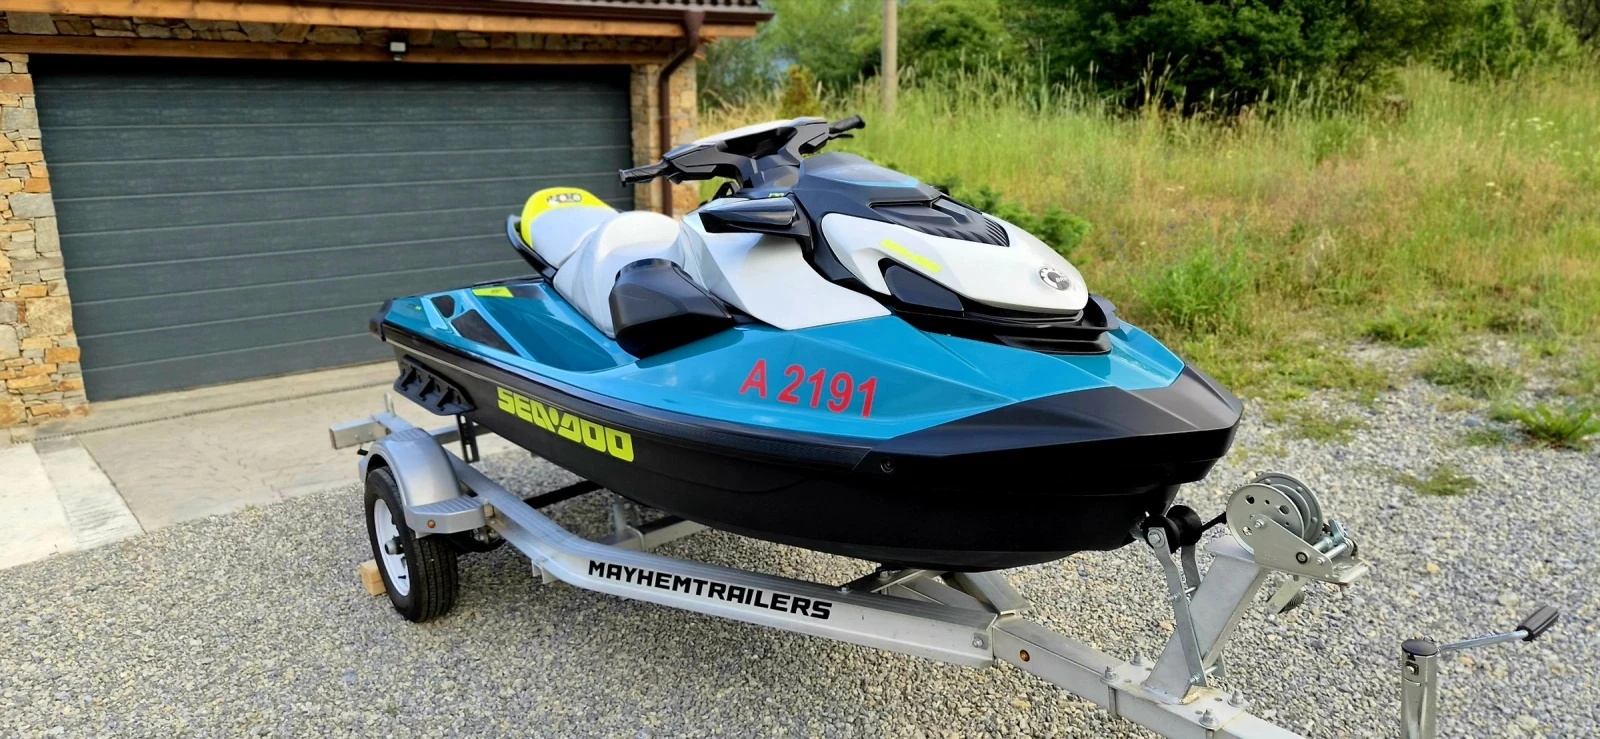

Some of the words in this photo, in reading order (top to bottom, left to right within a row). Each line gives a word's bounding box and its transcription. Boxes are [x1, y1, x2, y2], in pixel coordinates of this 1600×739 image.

[738, 358, 767, 398] A
[777, 364, 877, 418] 2191
[588, 560, 832, 620] MAYHEMTRAILERS
